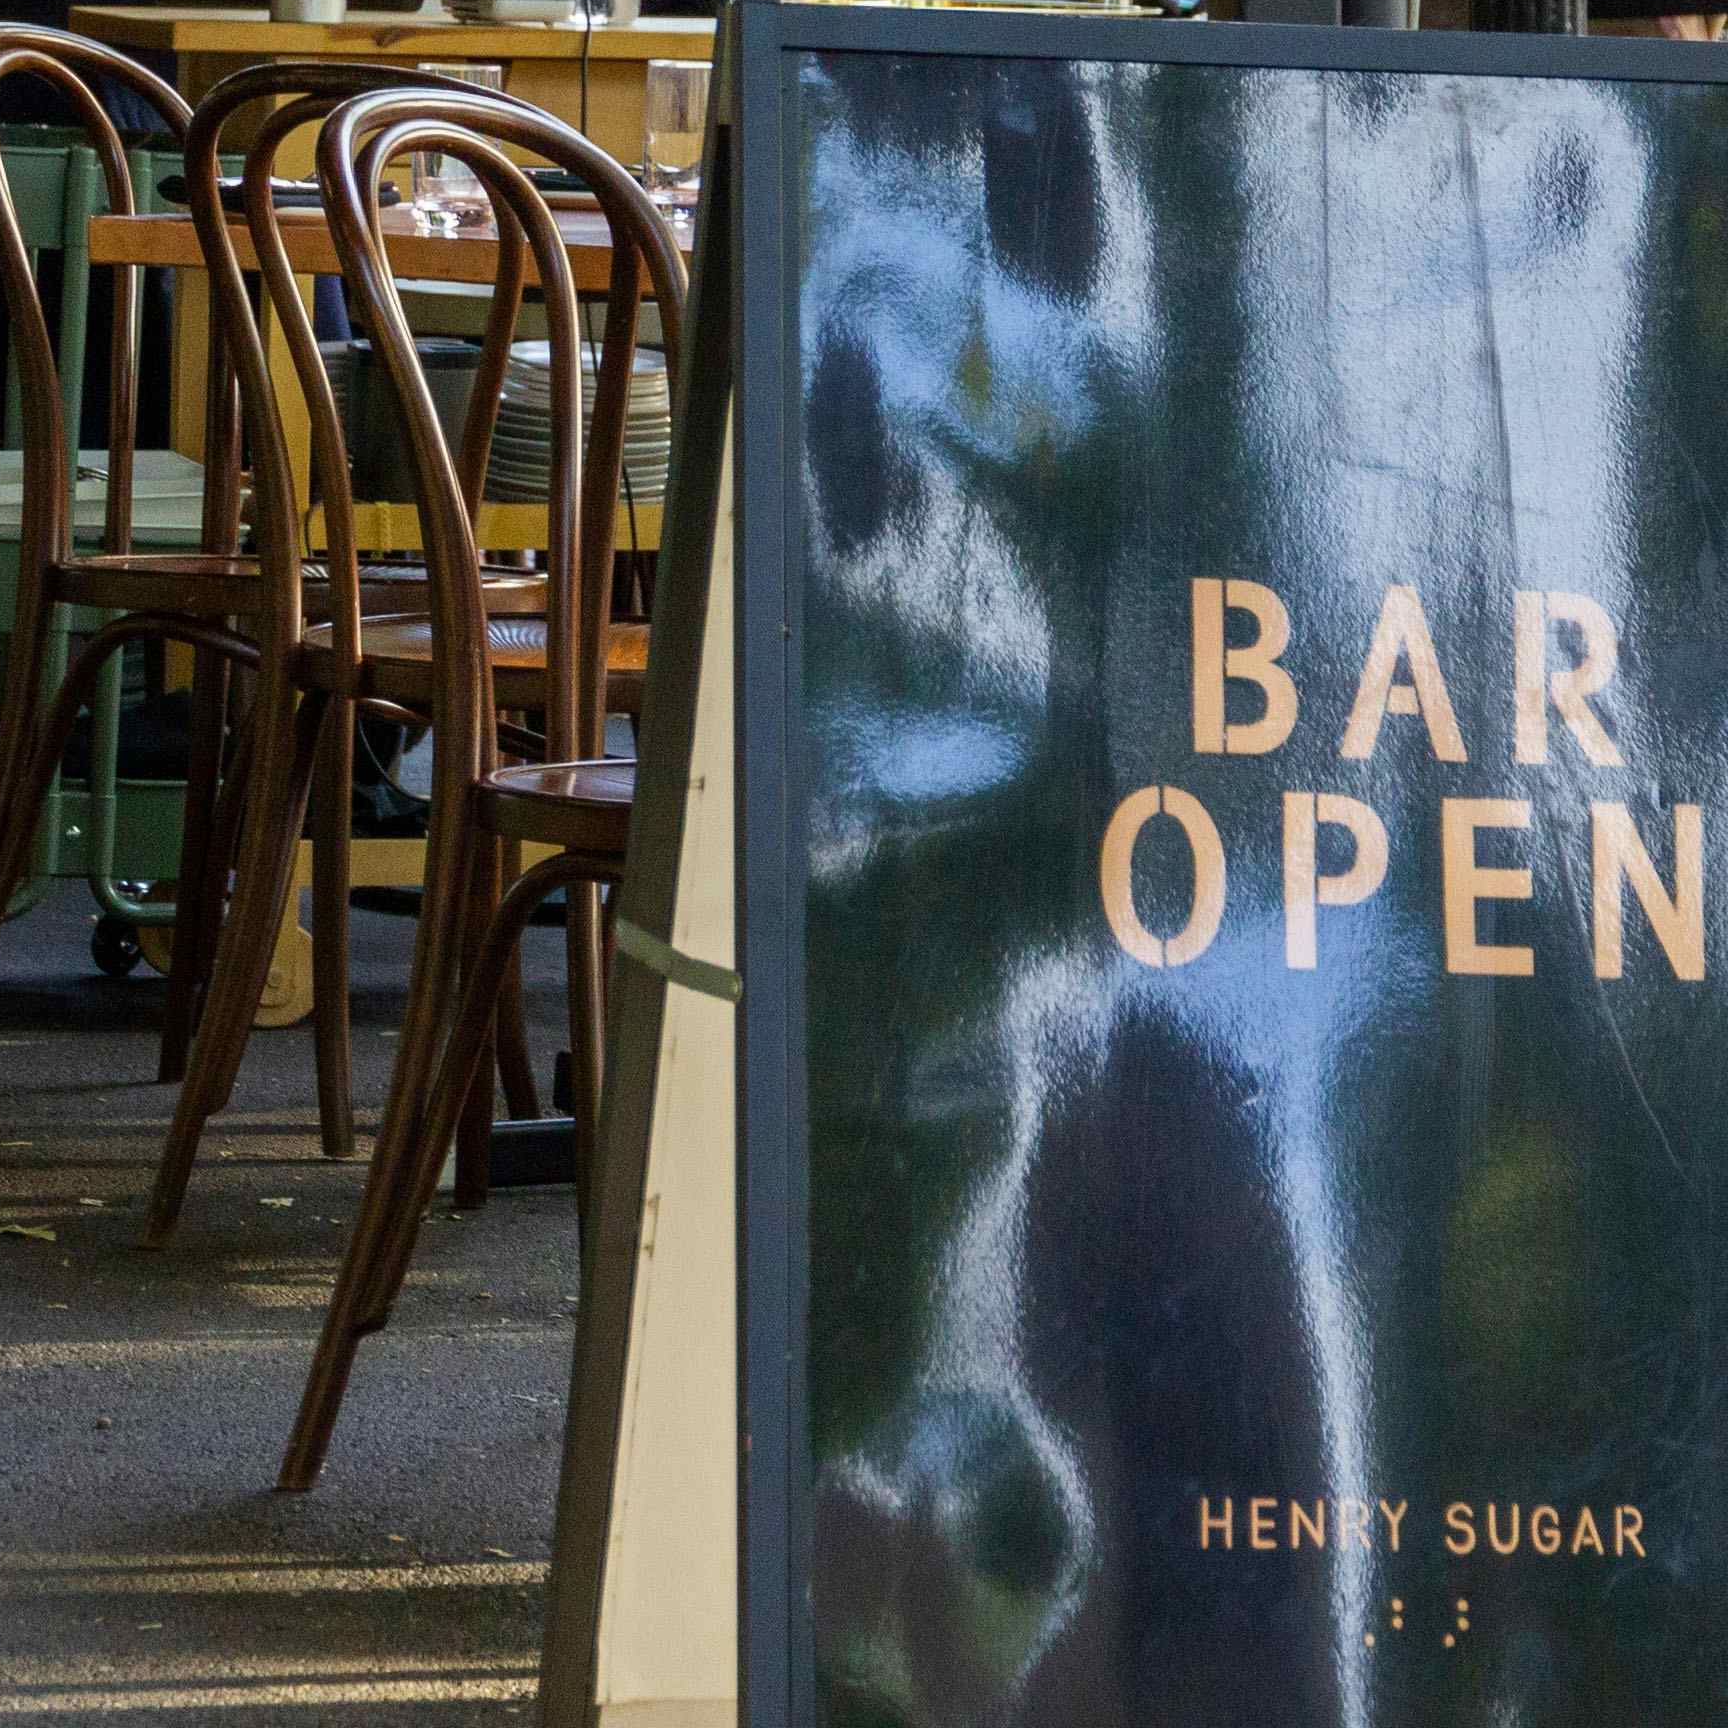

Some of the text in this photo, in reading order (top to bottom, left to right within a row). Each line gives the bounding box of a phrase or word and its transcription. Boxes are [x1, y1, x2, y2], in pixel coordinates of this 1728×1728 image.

[1189, 576, 1628, 768] BAR
[1100, 784, 1707, 982] OPEN
[1198, 1495, 1647, 1559] HENRY SUGAR
